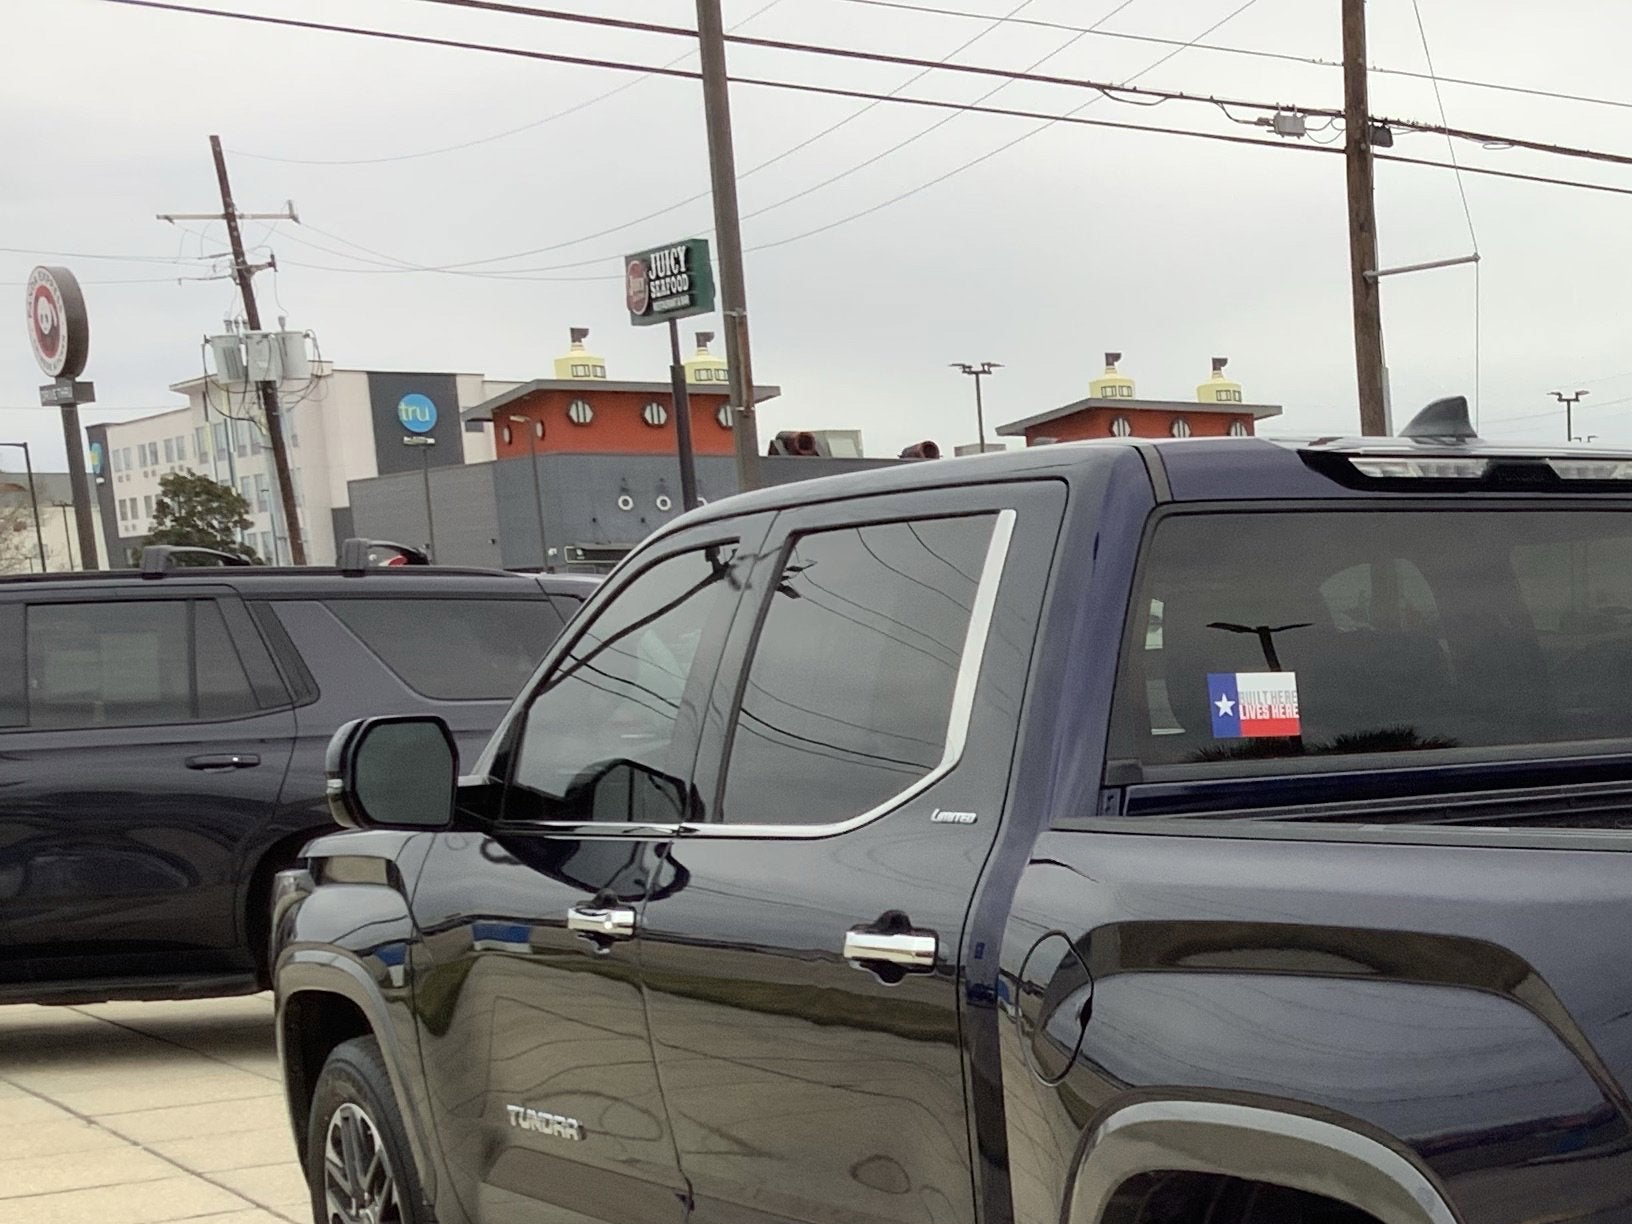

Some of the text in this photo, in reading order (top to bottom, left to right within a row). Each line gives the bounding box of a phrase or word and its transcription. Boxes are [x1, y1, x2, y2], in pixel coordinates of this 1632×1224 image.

[648, 245, 687, 280] JUICY
[649, 273, 690, 299] SEAFOOD
[398, 401, 430, 422] tru
[1239, 690, 1298, 705] BUILT HERE
[1239, 704, 1300, 720] LIVES HERE
[506, 1104, 580, 1141] TUNDRA
